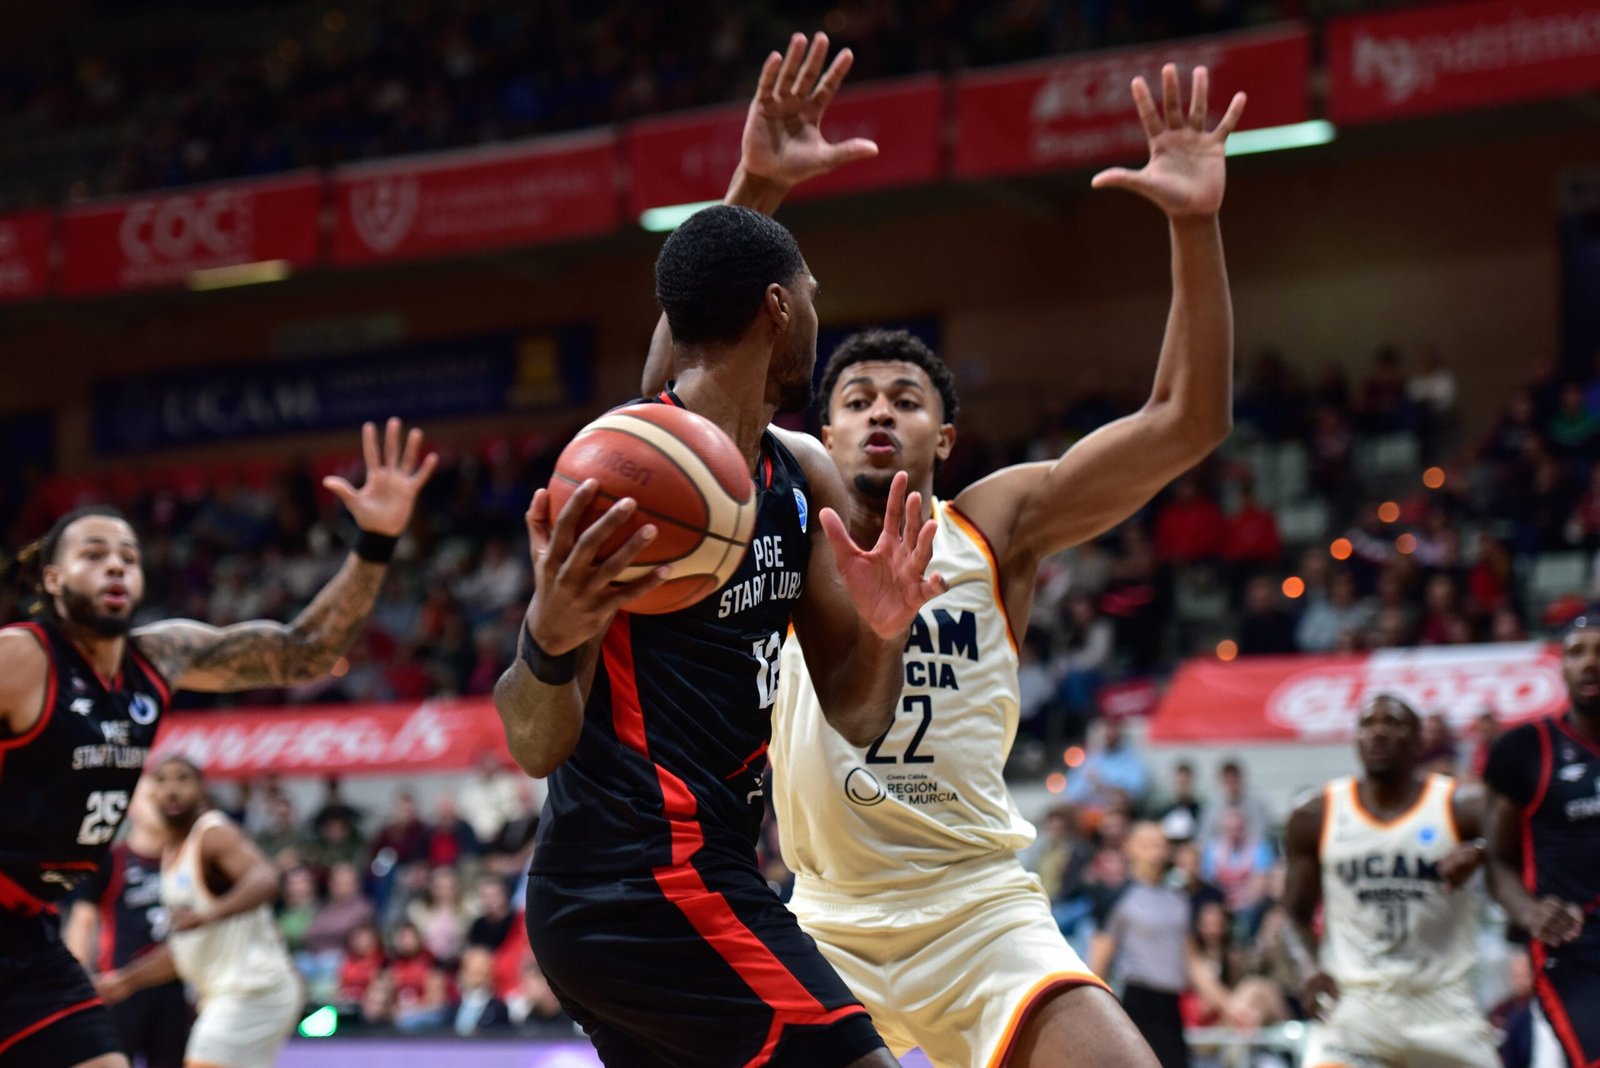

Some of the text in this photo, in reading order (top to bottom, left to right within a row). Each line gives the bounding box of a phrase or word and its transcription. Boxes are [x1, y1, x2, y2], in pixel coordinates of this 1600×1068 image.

[752, 535, 785, 572] PGE
[718, 573, 766, 618] START
[903, 609, 979, 662] AM
[752, 630, 781, 709] 12
[905, 660, 960, 691] CIA
[887, 782, 938, 795] REGIÓN
[908, 792, 959, 805] MURCIA
[76, 790, 129, 845] 25
